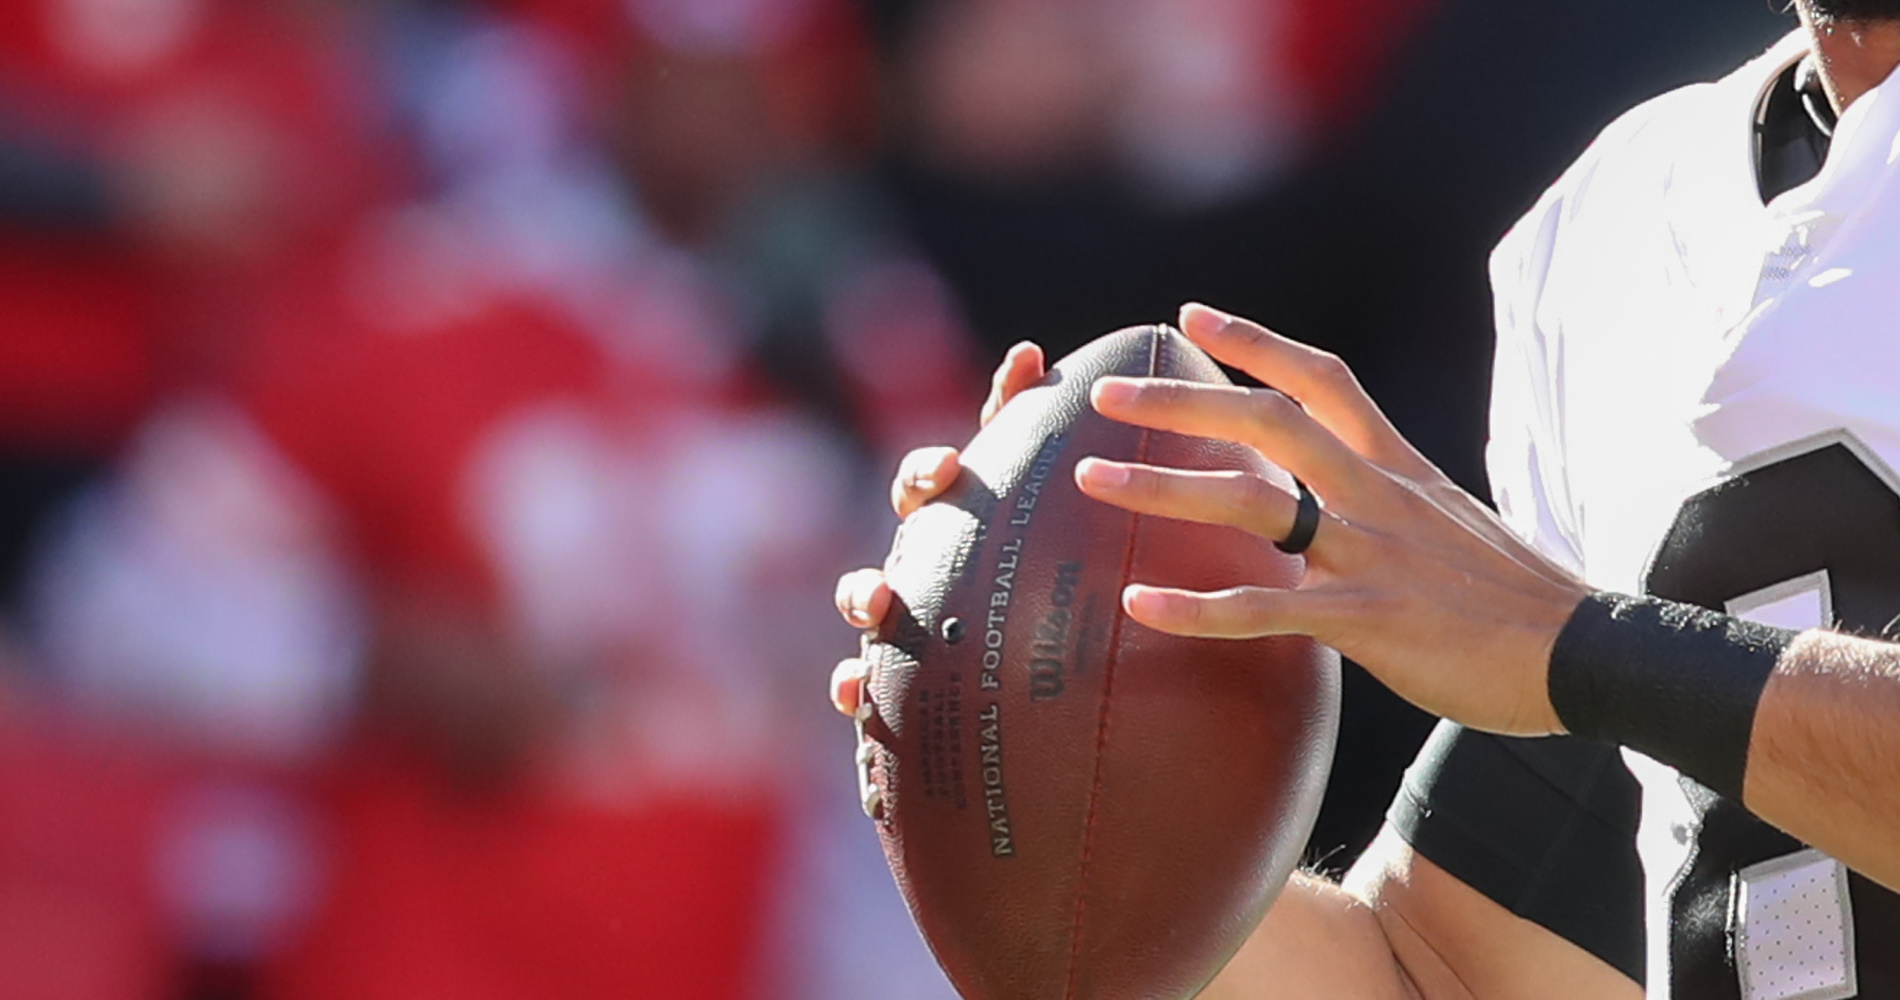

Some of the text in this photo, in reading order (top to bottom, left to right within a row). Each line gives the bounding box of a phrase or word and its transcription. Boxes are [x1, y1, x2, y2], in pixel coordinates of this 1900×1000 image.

[981, 538, 1022, 690] FOOTBALL
[1029, 560, 1083, 702] Wilson
[979, 704, 1013, 856] NATIONAL
